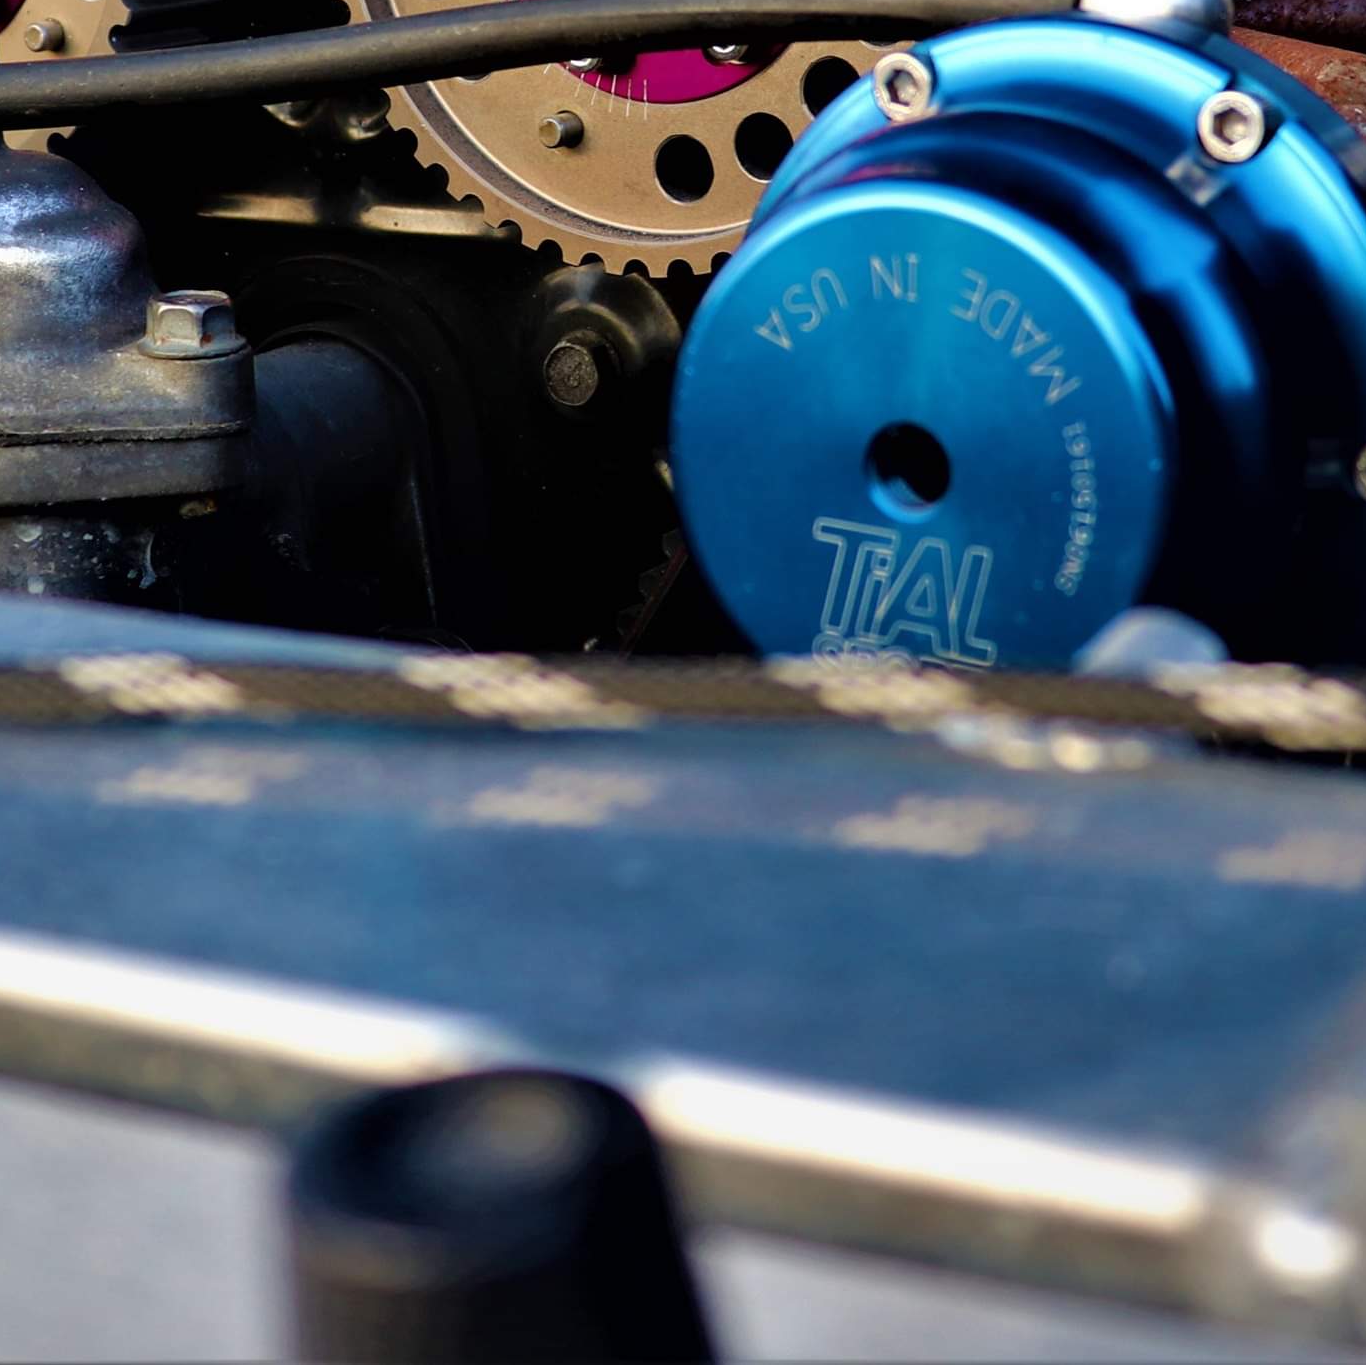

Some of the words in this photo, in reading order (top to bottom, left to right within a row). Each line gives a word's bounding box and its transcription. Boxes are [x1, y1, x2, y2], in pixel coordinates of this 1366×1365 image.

[753, 267, 849, 352] USA
[869, 252, 920, 303] IN
[948, 267, 1082, 406] MADE
